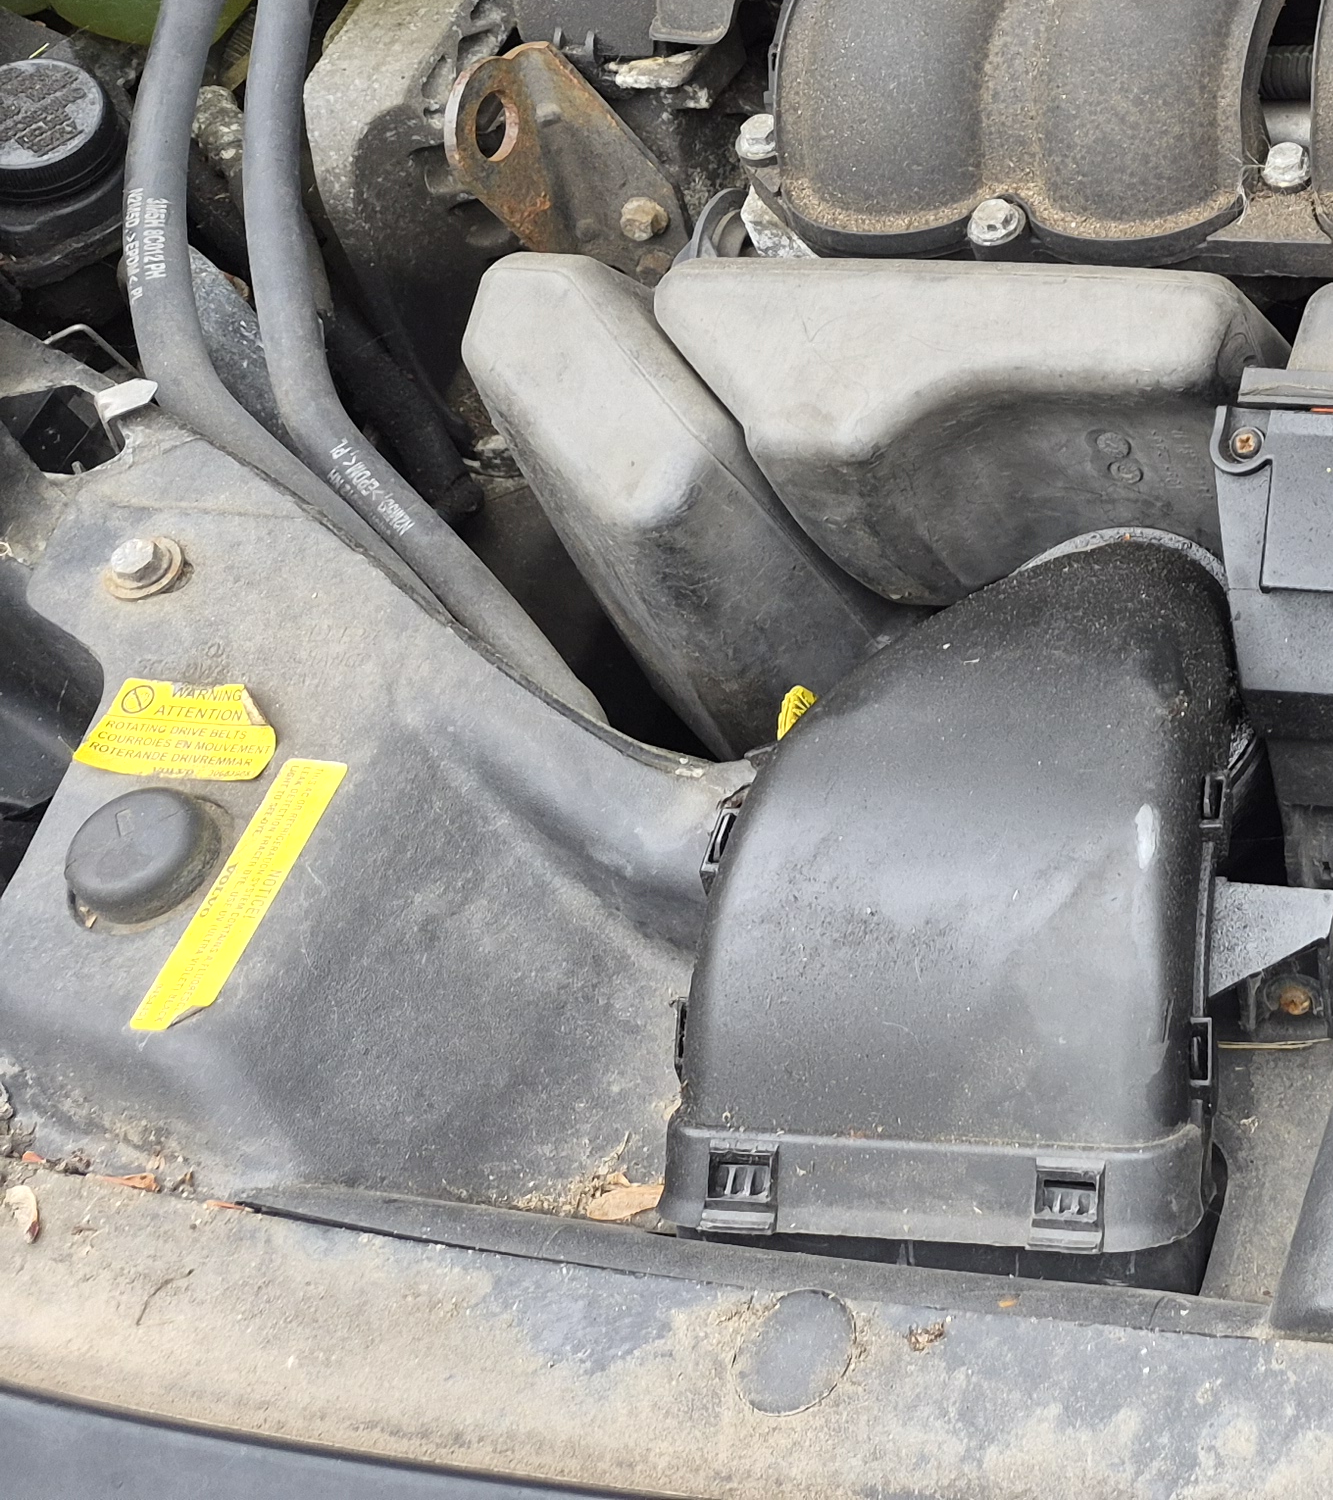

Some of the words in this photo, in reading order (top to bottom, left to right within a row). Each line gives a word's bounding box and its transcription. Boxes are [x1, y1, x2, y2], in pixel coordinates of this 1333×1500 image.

[143, 197, 168, 227] 3M5H
[143, 229, 164, 262] 8C012
[144, 262, 166, 279] PH
[330, 437, 352, 460] PL
[171, 687, 243, 703] WARNING
[154, 705, 243, 722] ATTENTION
[106, 720, 167, 734] ROTATING
[170, 726, 207, 737] DRIVE
[210, 729, 248, 740] BELTS
[89, 742, 168, 762] ROTERANDE
[171, 753, 253, 767] DRIVREMMAR
[97, 731, 171, 749] COURROIES
[175, 740, 191, 750] EN
[194, 741, 271, 756] MOUVEMENT
[279, 764, 300, 788] LIGHT
[293, 766, 312, 785] LEAK
[266, 788, 299, 831] DETECTION
[254, 812, 299, 874] REFRIGERATION
[197, 862, 239, 918] VOLVO
[222, 891, 240, 907] USE
[234, 877, 261, 909] SYSTEM
[241, 869, 283, 918] NOTICE!
[208, 912, 240, 952] CONTAINS
[153, 994, 178, 1022] BLACK
